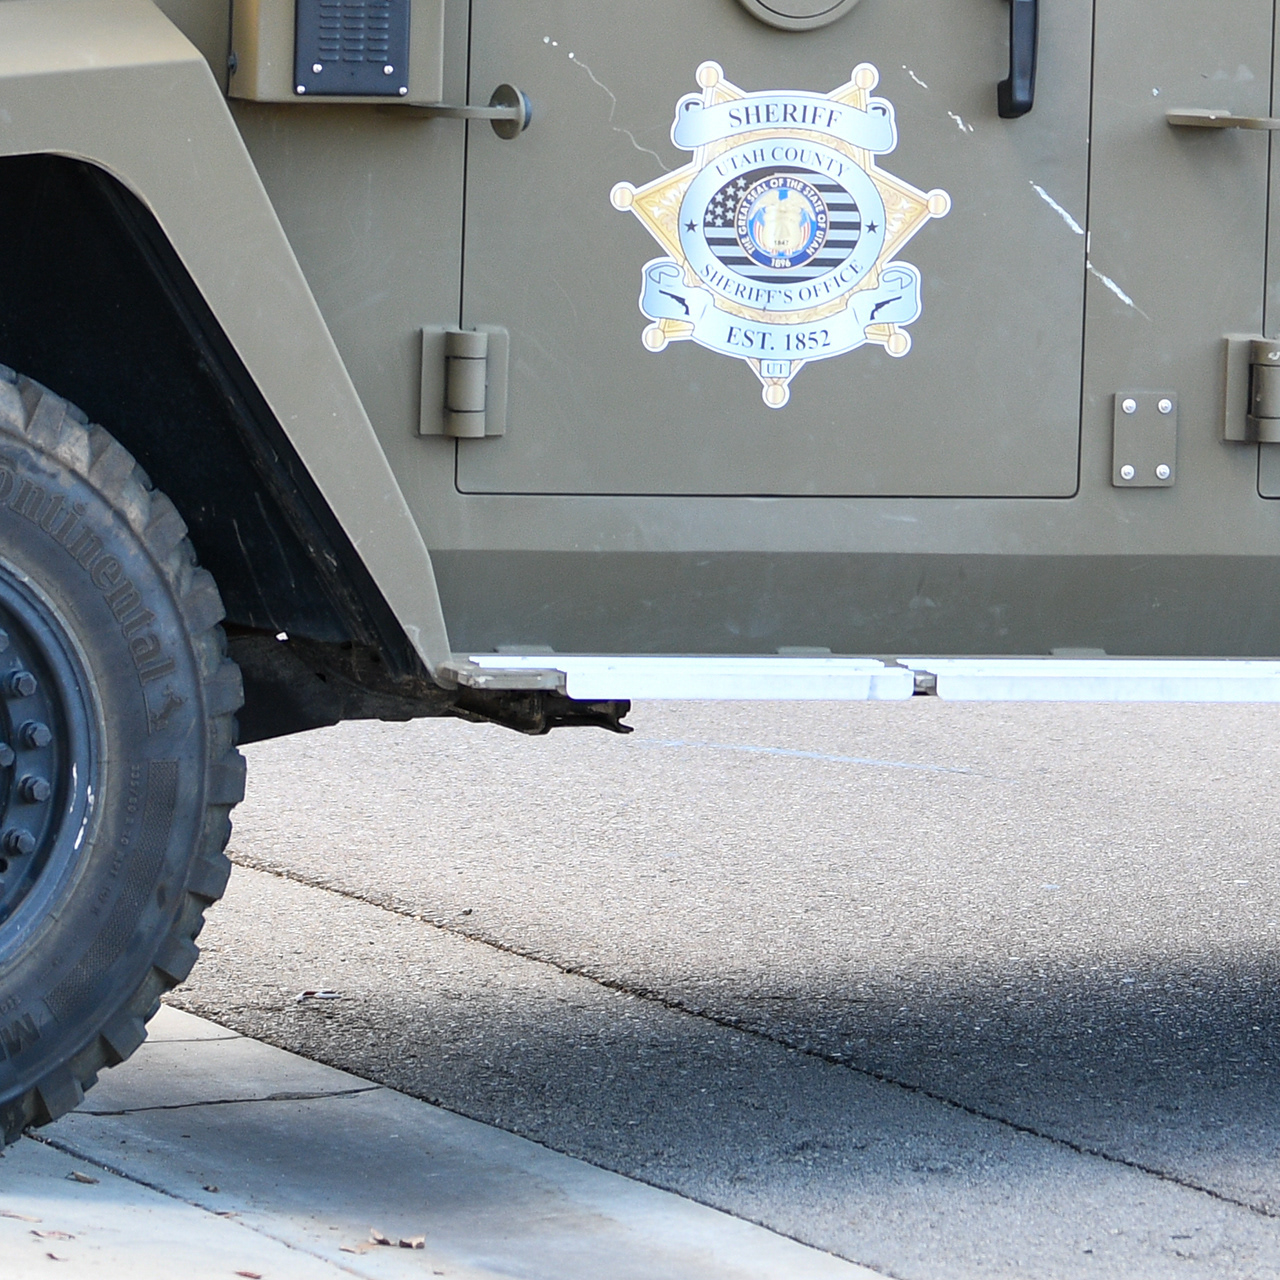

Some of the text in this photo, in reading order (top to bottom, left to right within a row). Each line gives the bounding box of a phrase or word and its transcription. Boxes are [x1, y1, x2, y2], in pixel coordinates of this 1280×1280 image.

[728, 103, 842, 128] SHERIFF
[716, 146, 850, 177] UTAH COUNTY
[738, 178, 826, 256] THE GREAT SEAL OF THE STATE OF UTAH
[771, 258, 791, 268] 1896
[799, 259, 863, 301] OFFICE
[726, 326, 831, 351] EST. 1852
[766, 363, 786, 375] UT
